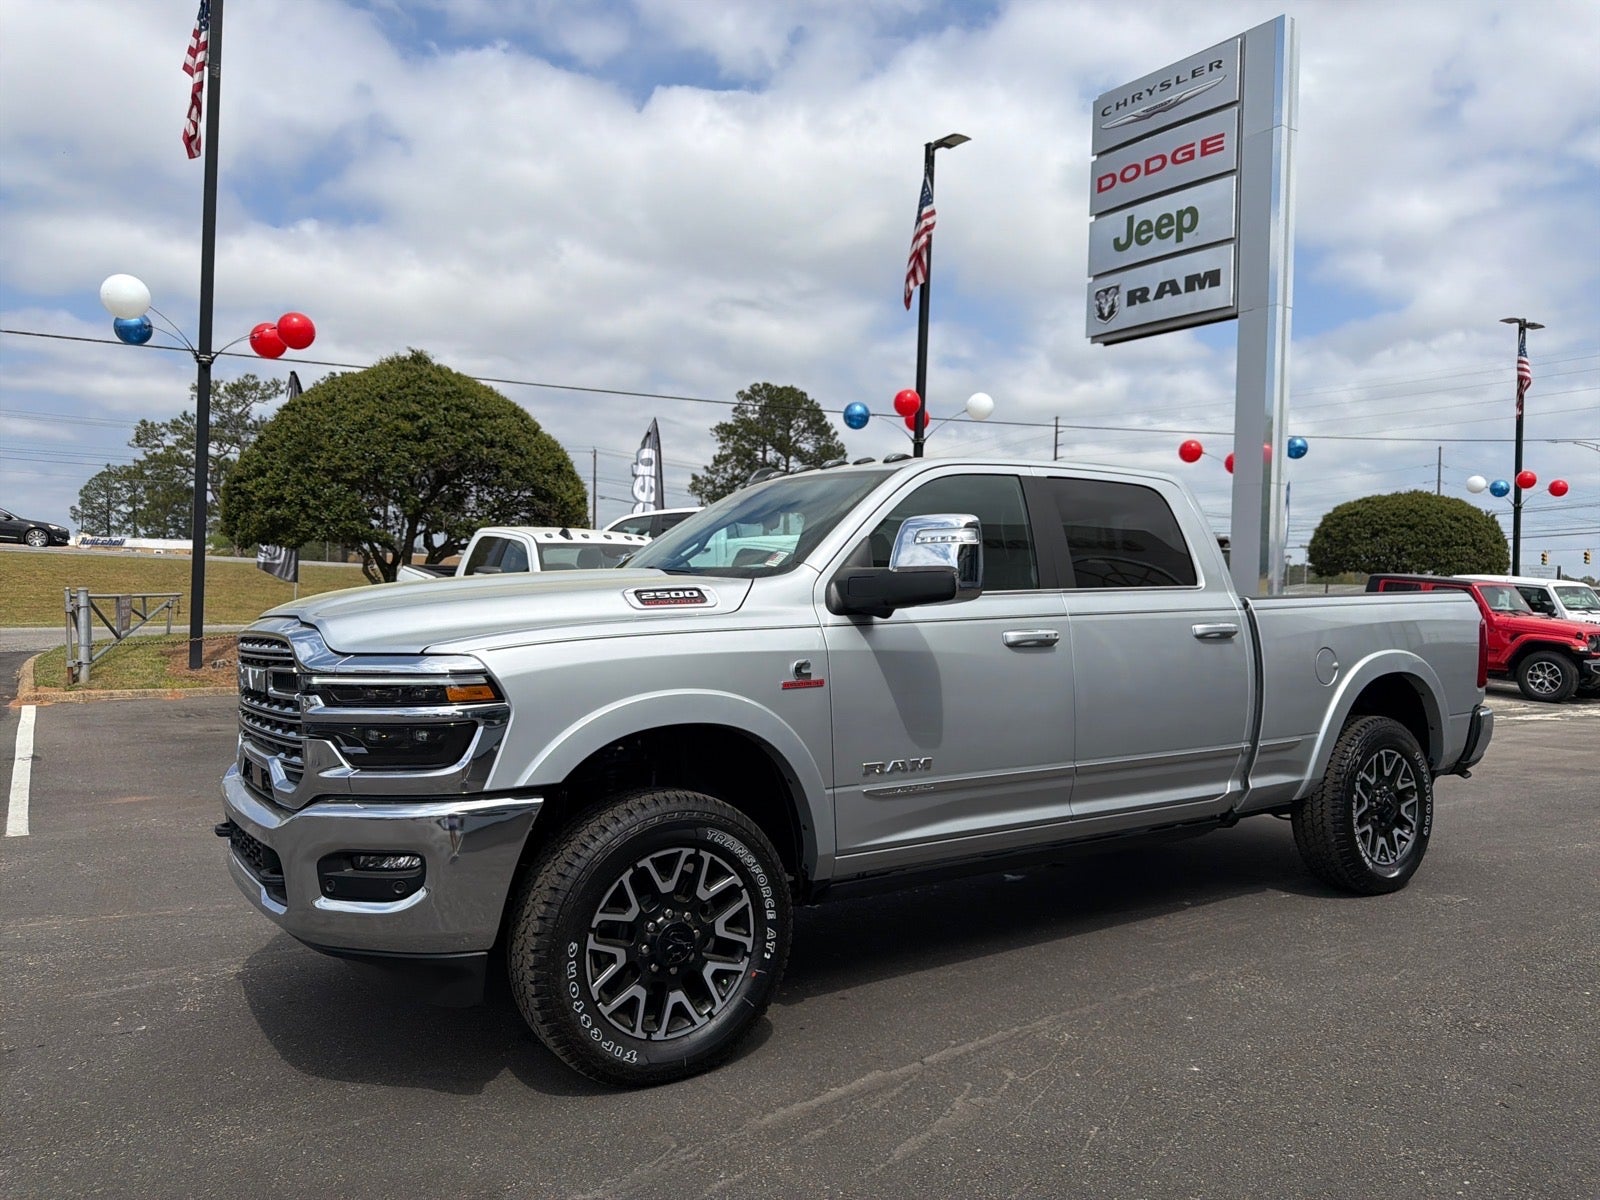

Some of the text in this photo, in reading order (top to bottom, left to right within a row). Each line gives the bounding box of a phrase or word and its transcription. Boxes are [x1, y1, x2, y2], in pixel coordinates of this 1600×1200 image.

[1101, 59, 1223, 117] CHRYSLER
[1097, 132, 1225, 194] DODGE
[1113, 206, 1199, 252] Jeep
[1127, 268, 1221, 308] RAM
[641, 590, 699, 600] 2500
[862, 757, 933, 777] RAM
[706, 829, 777, 920] TRANSFORCE
[566, 942, 638, 1064] Firestone
